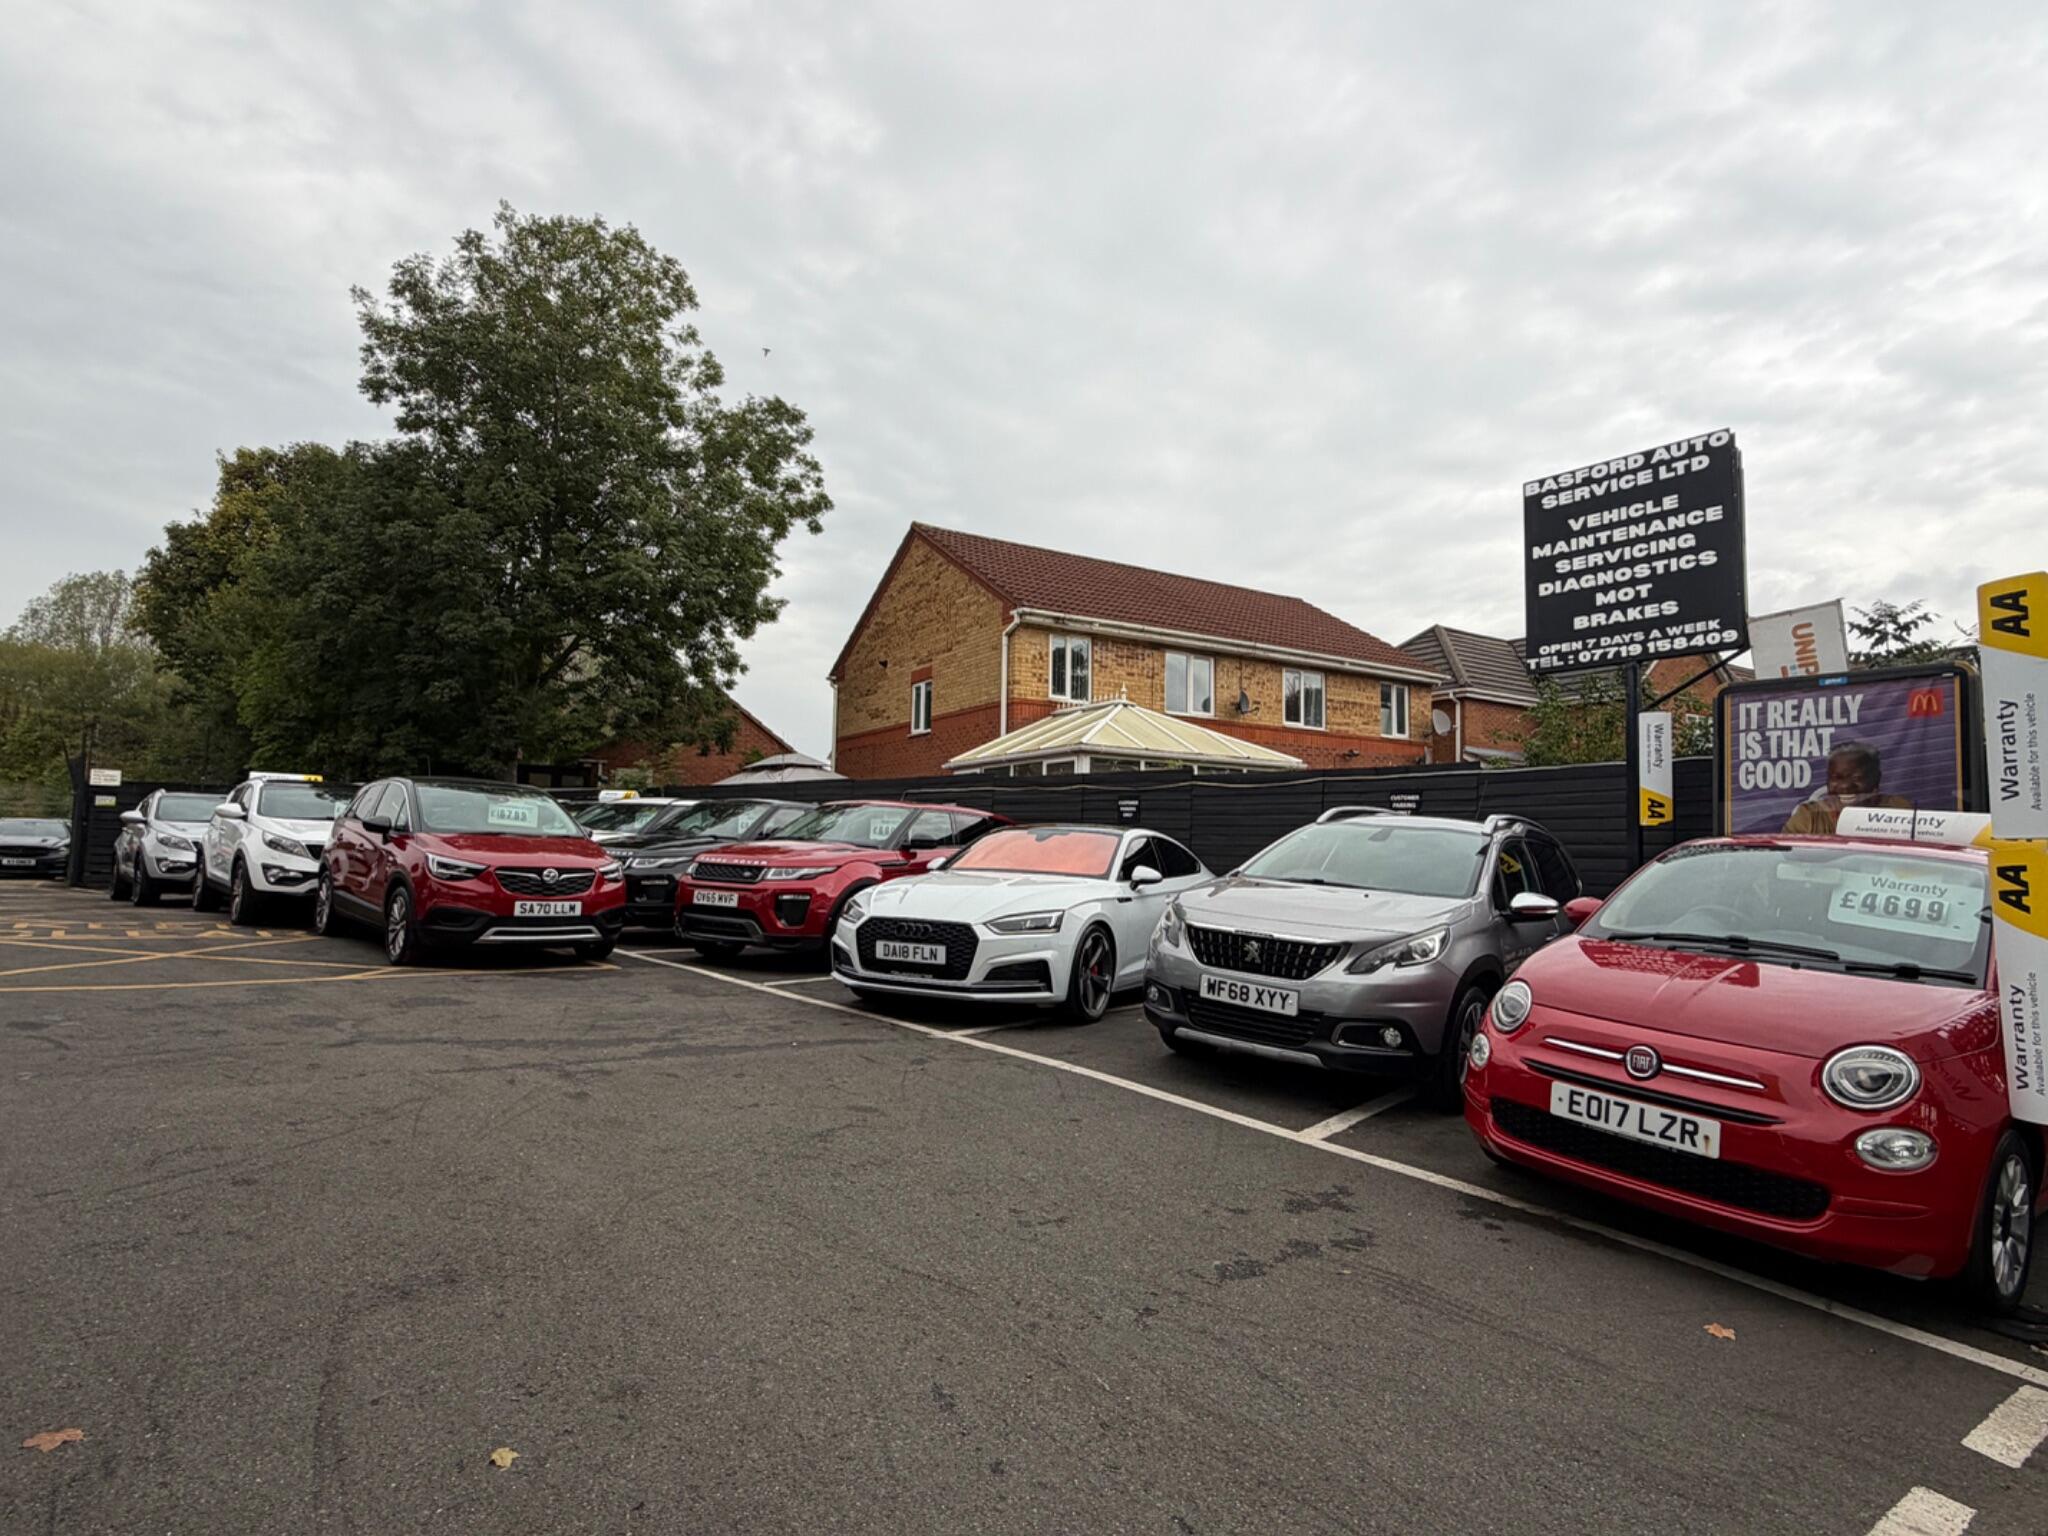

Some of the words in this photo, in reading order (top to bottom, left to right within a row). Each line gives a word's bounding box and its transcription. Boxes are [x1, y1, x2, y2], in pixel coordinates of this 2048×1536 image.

[1524, 454, 1645, 497] BASFORD
[1650, 430, 1730, 464] AUTO
[1541, 469, 1653, 509] SERVICE
[1658, 454, 1710, 480] LTD
[1567, 494, 1680, 531] VEHICLE
[1532, 505, 1724, 559] MAINTENANCE
[1555, 533, 1697, 573] SERVICING
[1538, 550, 1718, 597] DIAGNOSTICS
[1595, 583, 1653, 607] MOT
[1573, 600, 1680, 630] BRAKES
[1989, 589, 2031, 638] AA
[1539, 640, 1582, 655] OPEN
[1585, 638, 1597, 649] 7
[1600, 631, 1646, 647] DAYS
[1649, 629, 1662, 640] A
[1666, 619, 1721, 636] WEEK
[1579, 643, 1643, 664] 07719
[1647, 629, 1738, 654] 158409
[1738, 702, 1762, 731] IT
[1767, 694, 1863, 729] REALLY
[2024, 693, 2037, 728] vehicle
[1653, 723, 1665, 768] Warranty
[1738, 730, 1762, 761] IS
[1766, 727, 1836, 759] THAT
[1996, 700, 2021, 802] Warranty
[2026, 729, 2038, 748] this
[2027, 749, 2039, 763] for
[1738, 759, 1812, 790] GOOD
[2029, 765, 2042, 811] Available
[1647, 798, 1665, 819] AA
[1871, 876, 1948, 898] Warranty
[1996, 864, 2031, 915] AA
[520, 903, 551, 914] SA70
[554, 903, 576, 914] LLM
[1839, 891, 1945, 922] £4699
[883, 943, 910, 959] DA18
[913, 945, 938, 961] FLN
[1206, 978, 1250, 1002] WF68
[1254, 987, 1290, 1010] XYY
[2026, 972, 2038, 1008] vehicle
[2009, 983, 2030, 1091] Warranty
[2030, 1011, 2041, 1029] this
[2031, 1031, 2041, 1046] for
[1631, 1054, 1651, 1070] FIAT
[2033, 1048, 2046, 1096] Available
[1638, 1107, 1700, 1148] LZR
